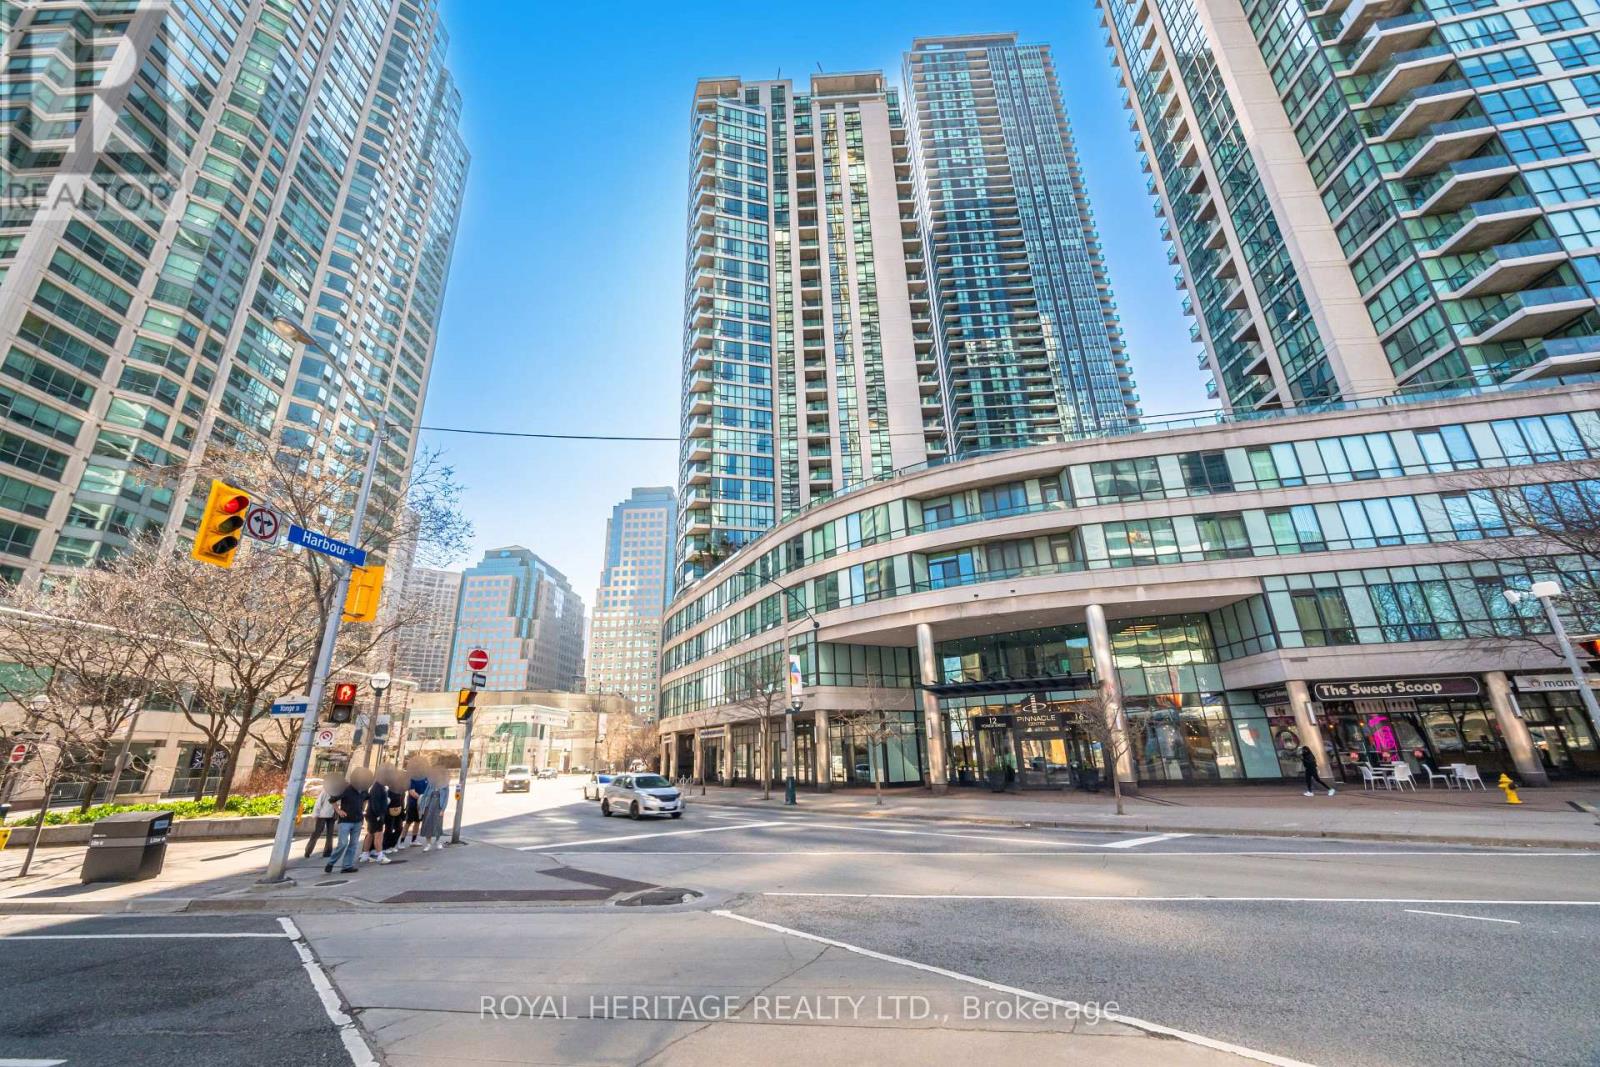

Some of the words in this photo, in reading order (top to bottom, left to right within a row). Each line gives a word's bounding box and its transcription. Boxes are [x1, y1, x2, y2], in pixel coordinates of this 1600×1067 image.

[302, 531, 348, 556] Harbour
[1320, 685, 1348, 696] The
[1350, 683, 1393, 695] Sweet
[1395, 681, 1442, 694] Scoop
[989, 717, 997, 725] 12
[1016, 714, 1056, 722] PINNACLE
